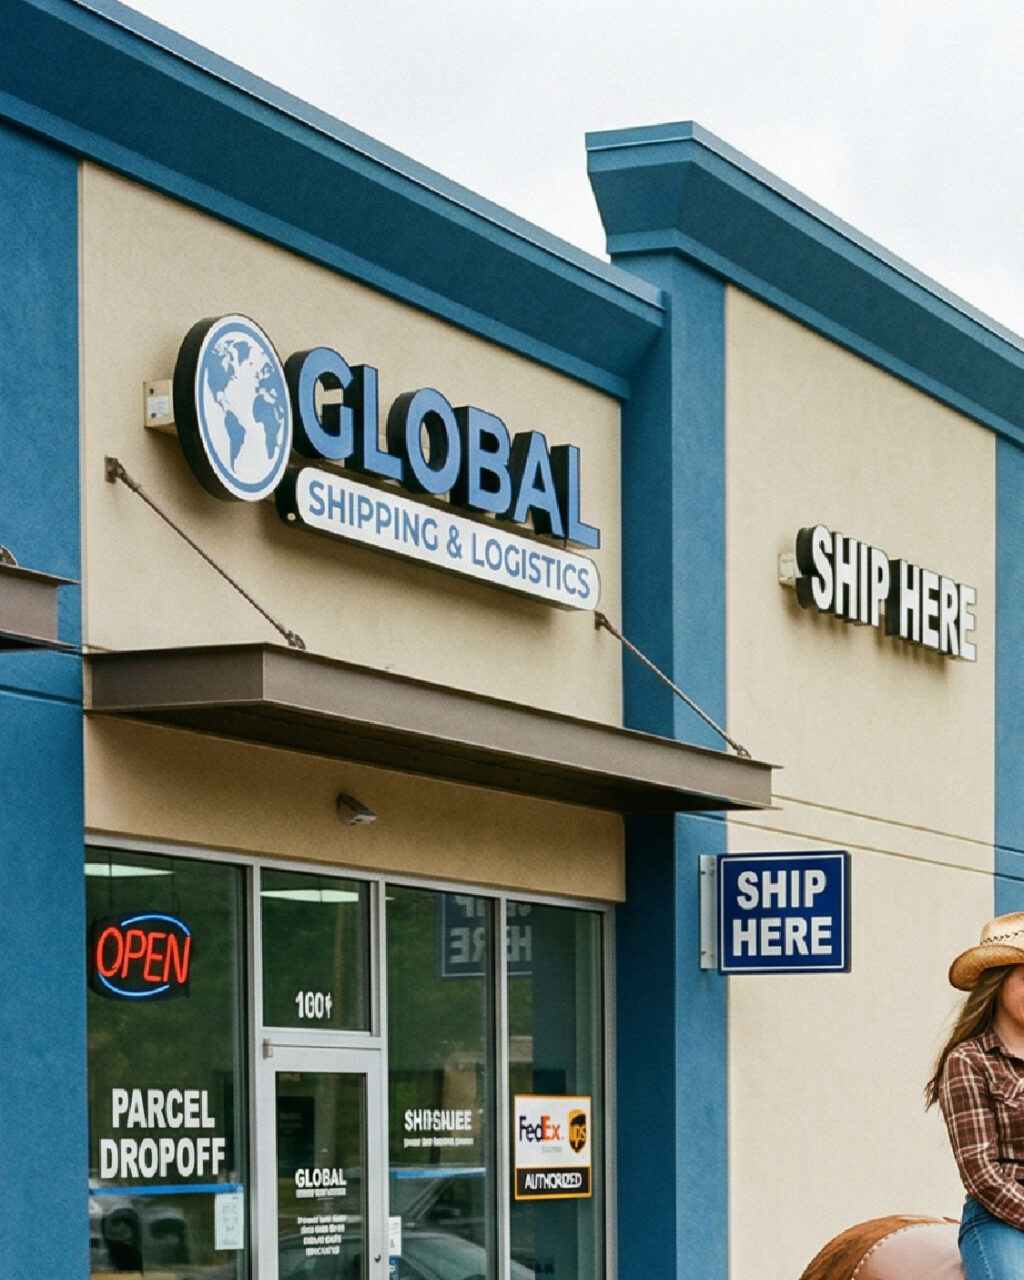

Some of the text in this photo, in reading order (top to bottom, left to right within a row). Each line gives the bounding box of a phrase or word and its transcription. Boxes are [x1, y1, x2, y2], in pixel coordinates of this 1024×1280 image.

[297, 346, 600, 549] GLOBAL
[309, 480, 591, 600] SHIPPING & LOGISTICS
[811, 524, 977, 662] SHIP HERE
[736, 869, 827, 910] SHIP
[96, 926, 192, 984] OPEN
[732, 916, 833, 957] HERE
[111, 1087, 216, 1129] PARCEL
[519, 1115, 561, 1142] FedEx
[99, 1136, 226, 1179] DROPOFF
[294, 1168, 347, 1188] GLOBAL
